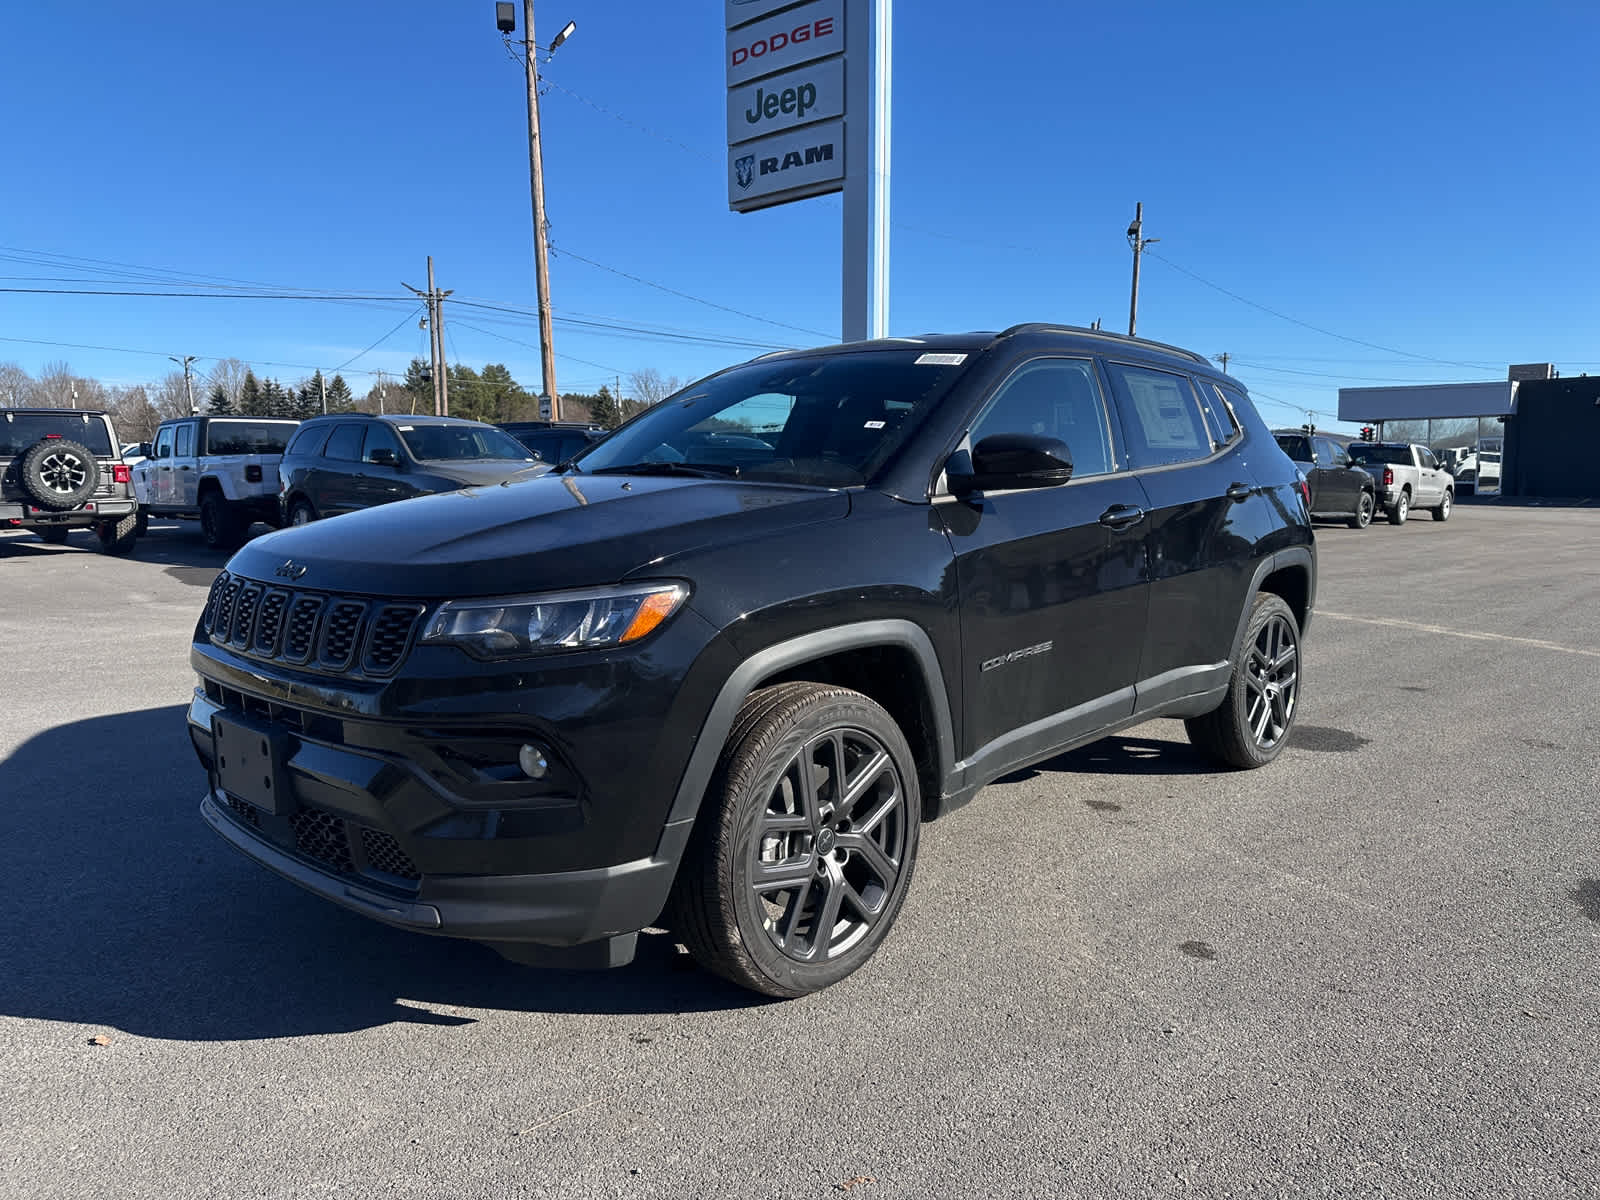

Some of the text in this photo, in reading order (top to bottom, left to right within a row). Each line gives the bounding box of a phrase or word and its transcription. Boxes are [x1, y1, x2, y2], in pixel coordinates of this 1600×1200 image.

[732, 17, 834, 66] DODGE
[746, 82, 816, 124] Jeep
[760, 144, 833, 176] RAM
